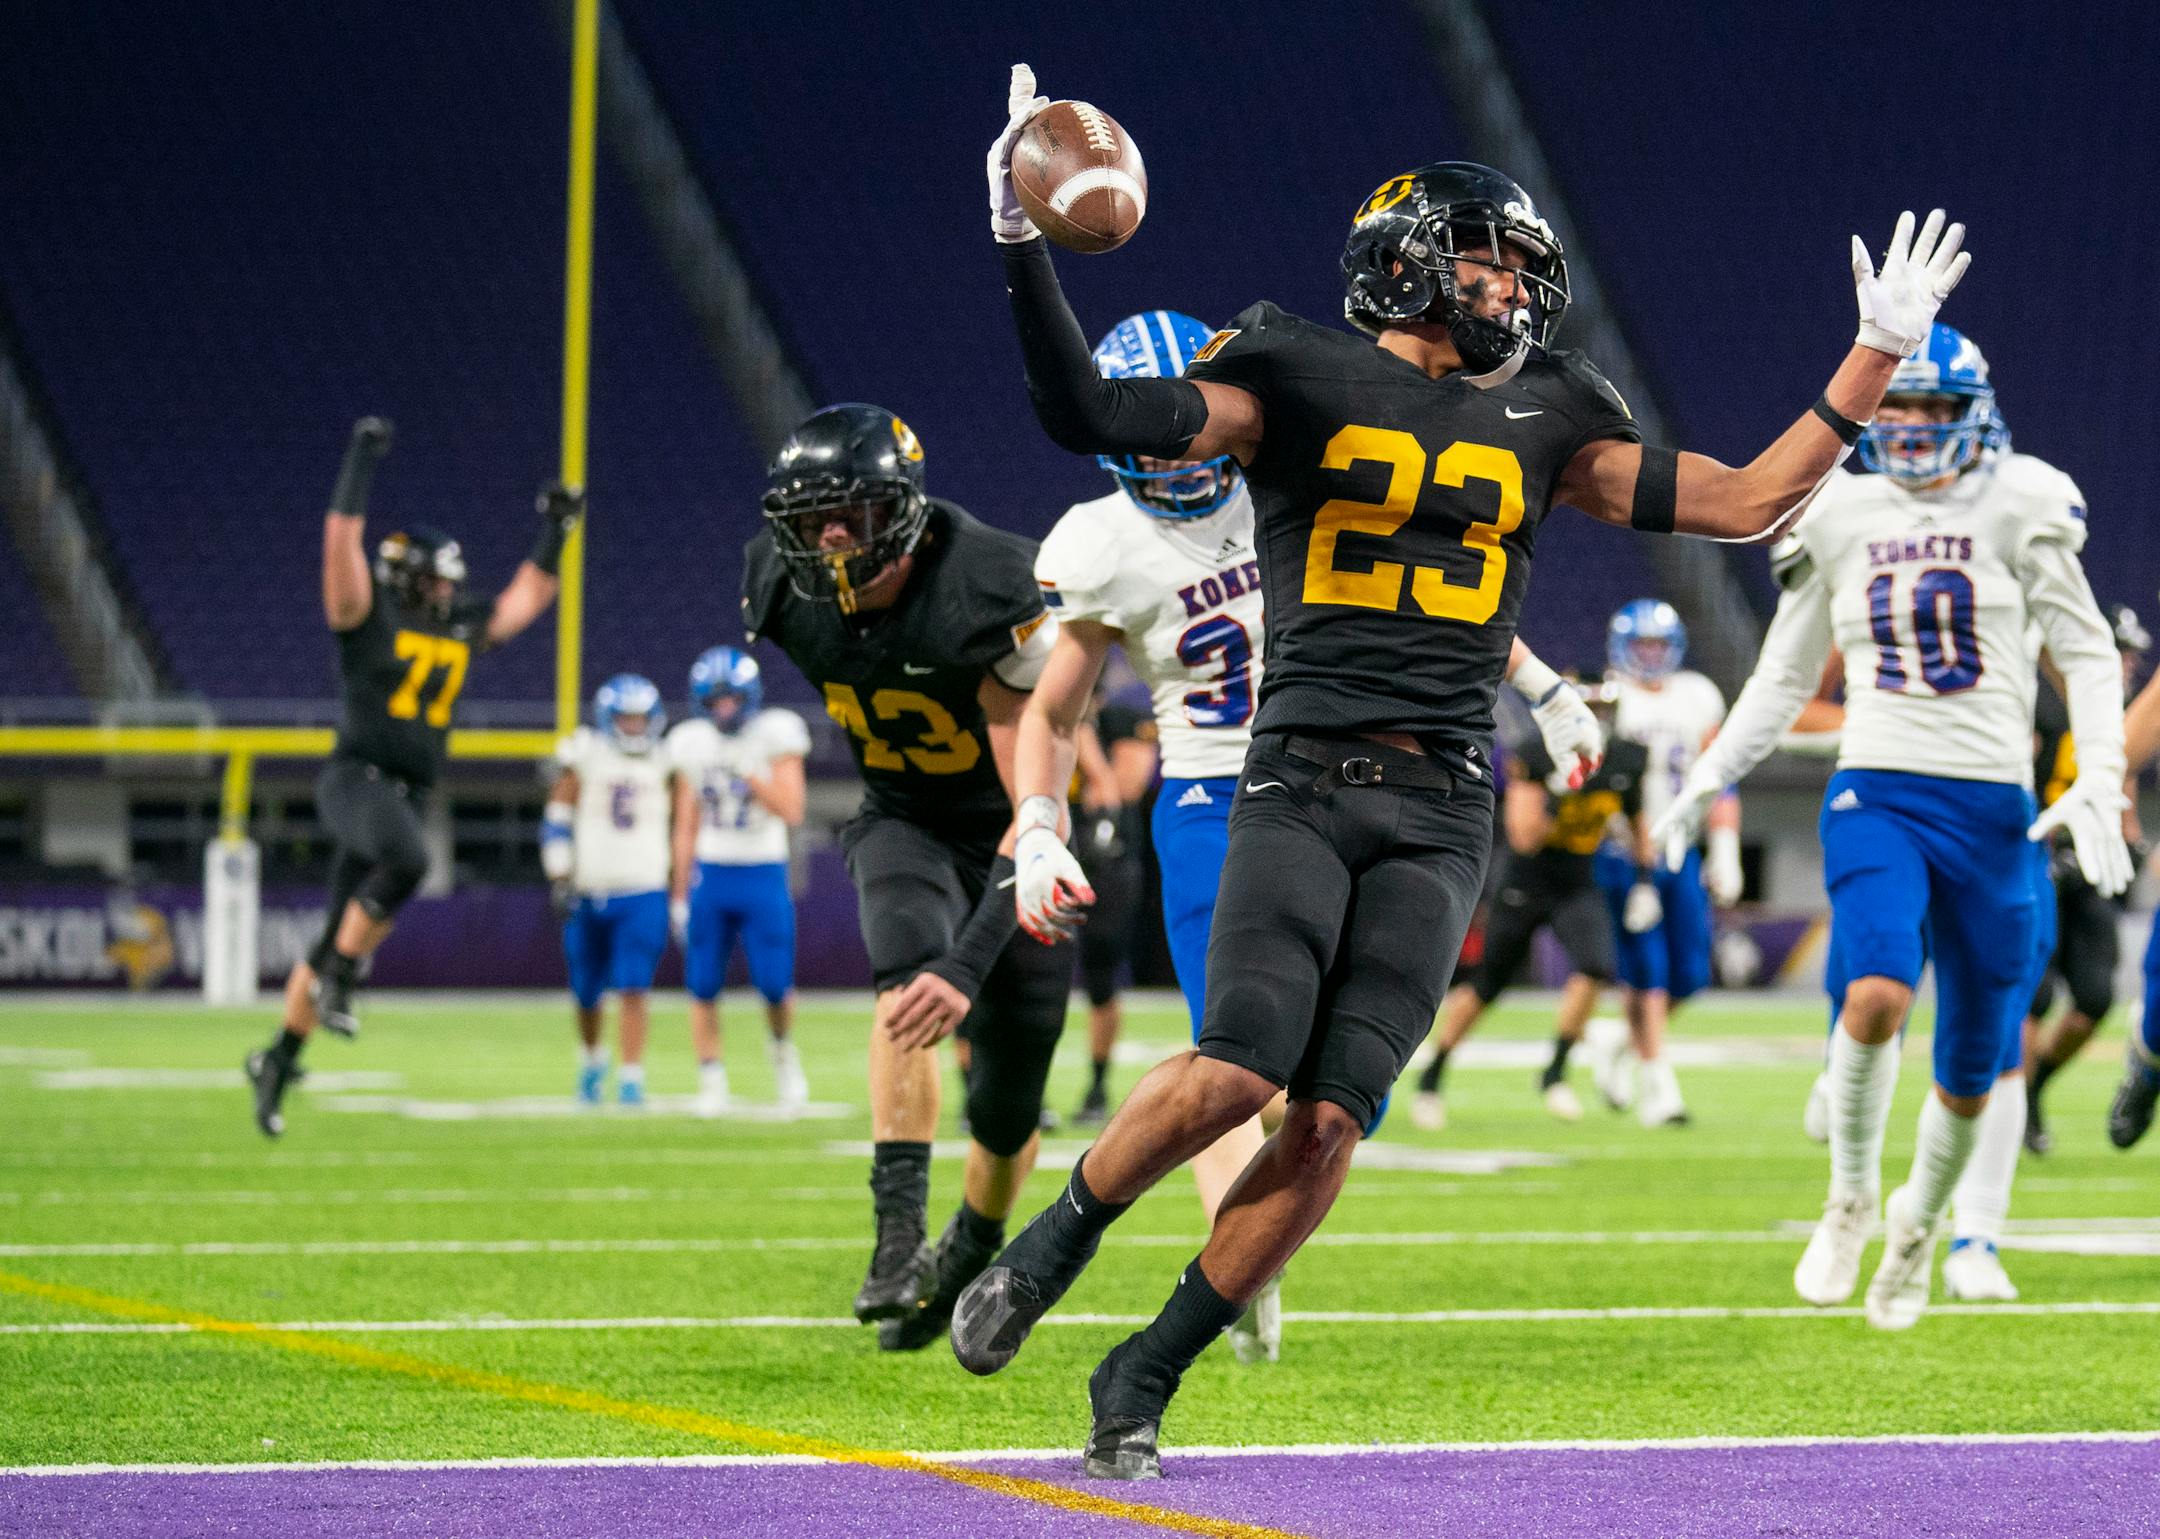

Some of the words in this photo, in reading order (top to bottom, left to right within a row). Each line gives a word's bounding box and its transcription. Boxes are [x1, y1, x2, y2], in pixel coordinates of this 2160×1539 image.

[1302, 424, 1525, 625] 23
[1867, 535, 1972, 566] KOMETS
[387, 629, 470, 728] 77
[1176, 614, 1264, 729] 3
[1866, 567, 1985, 696] 10
